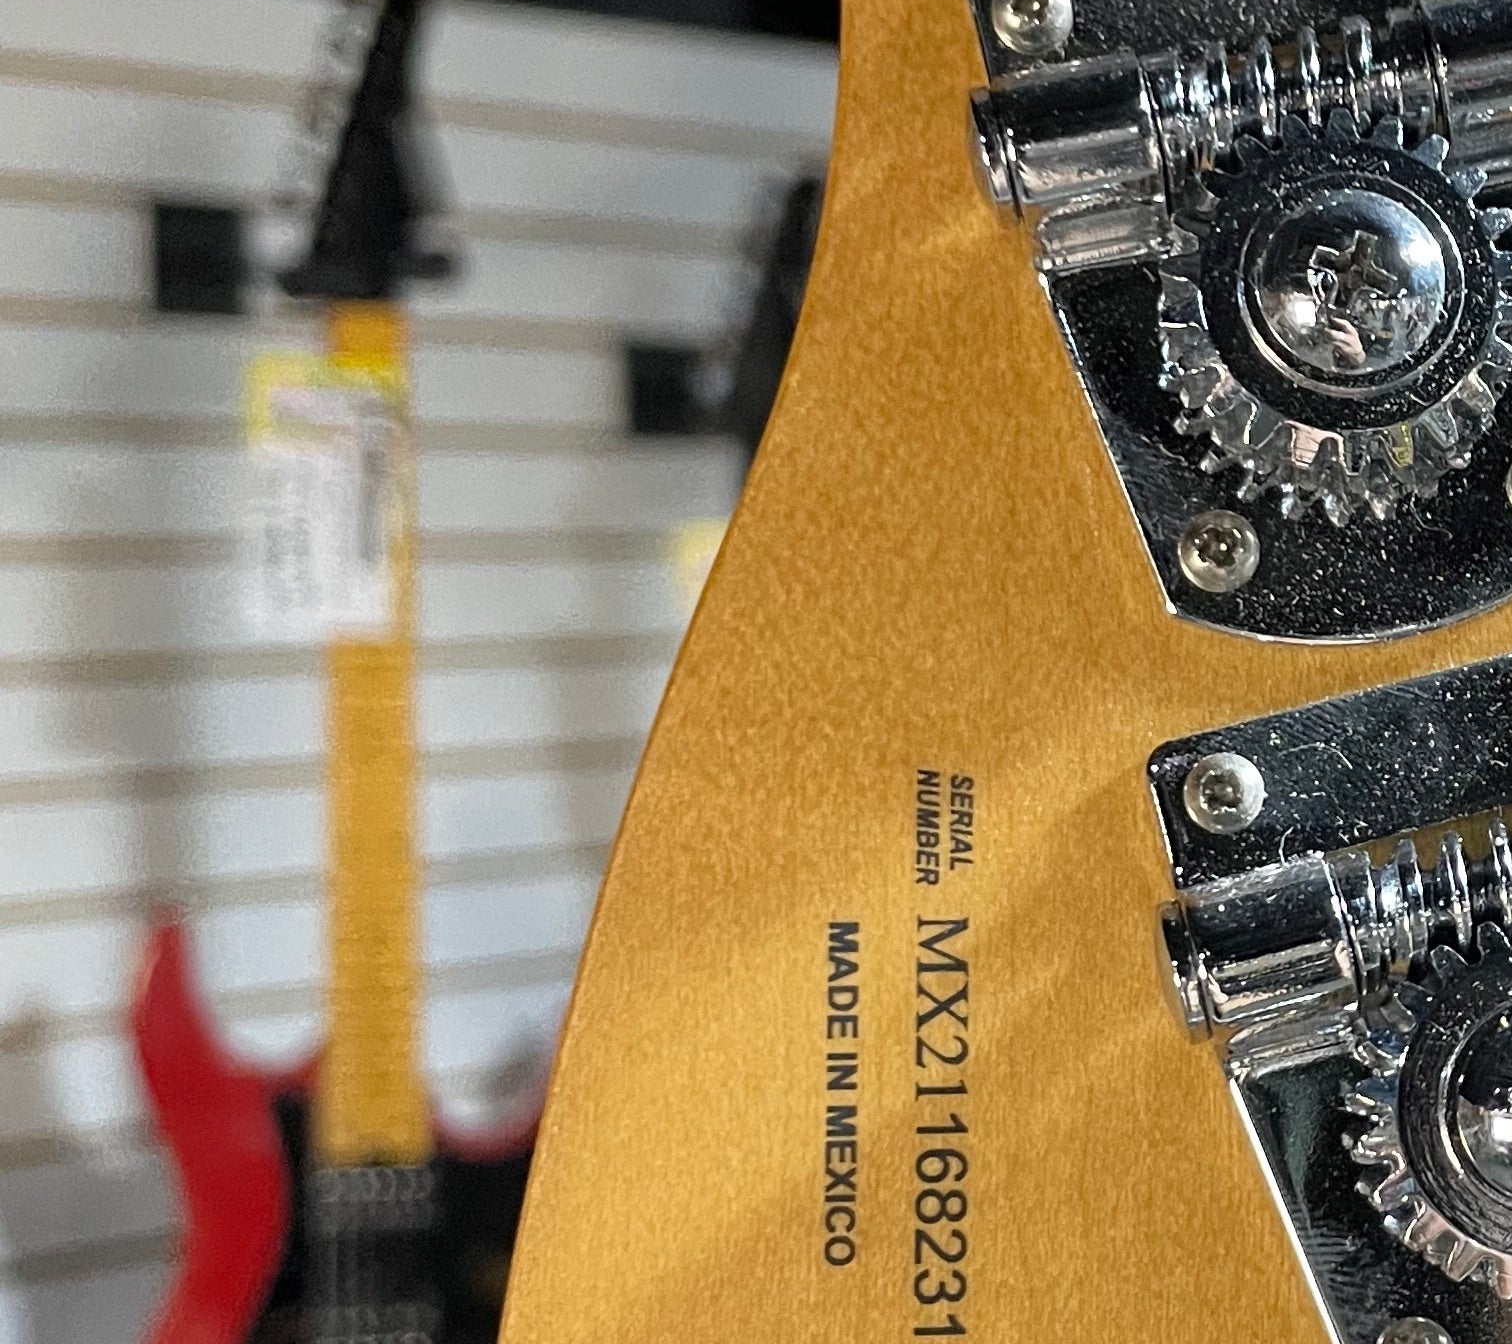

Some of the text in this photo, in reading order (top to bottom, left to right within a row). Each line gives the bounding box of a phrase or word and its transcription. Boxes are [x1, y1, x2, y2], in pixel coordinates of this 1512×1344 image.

[914, 768, 941, 887] NUMBER
[949, 773, 974, 872] SERIAL
[823, 920, 860, 1268] MADE IN MEXICO
[912, 914, 971, 1338] MX21168231
